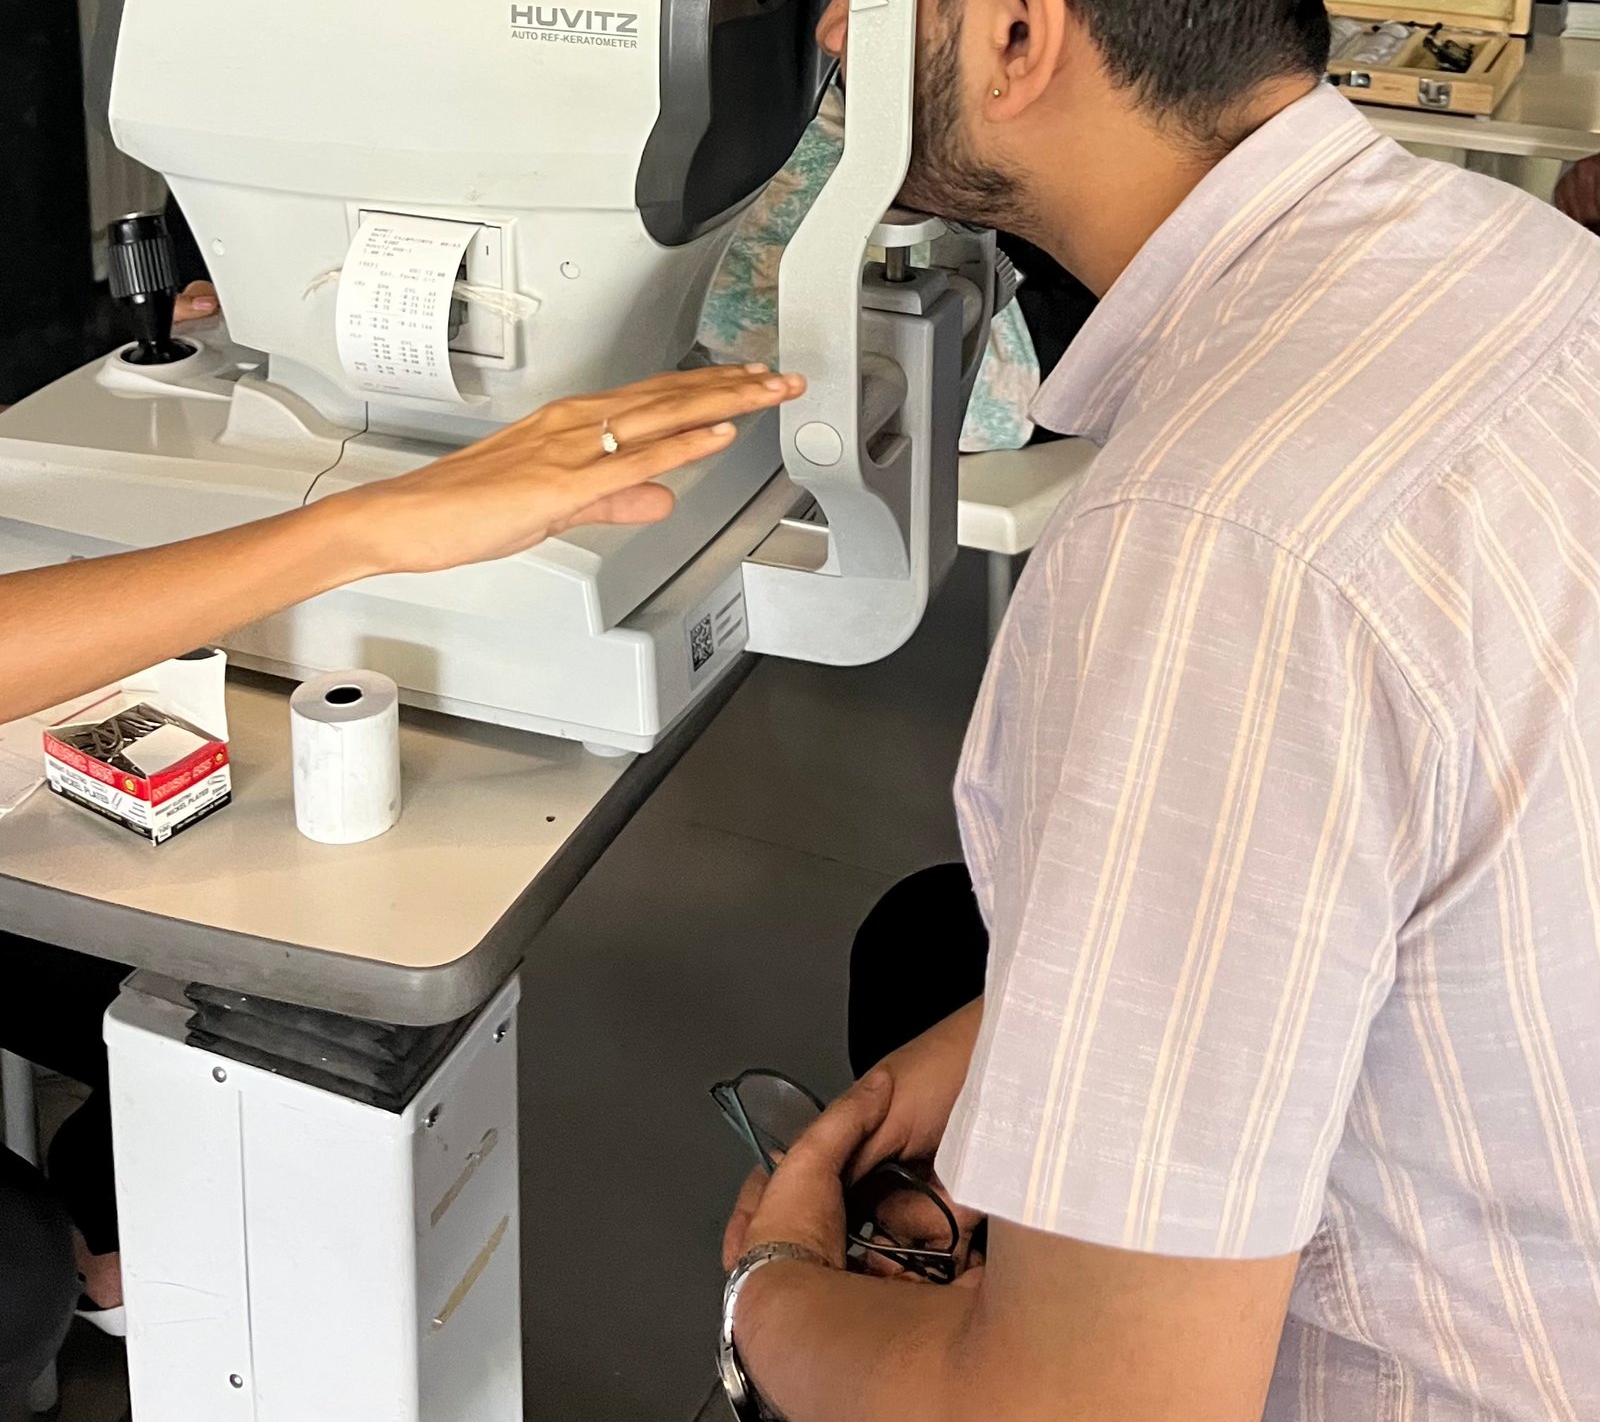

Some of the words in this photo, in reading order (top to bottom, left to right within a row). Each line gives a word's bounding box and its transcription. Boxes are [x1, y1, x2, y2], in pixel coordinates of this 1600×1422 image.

[511, 4, 638, 34] HUVITZ
[511, 30, 539, 41] AUTO
[541, 32, 638, 49] REF-KERATOMETER
